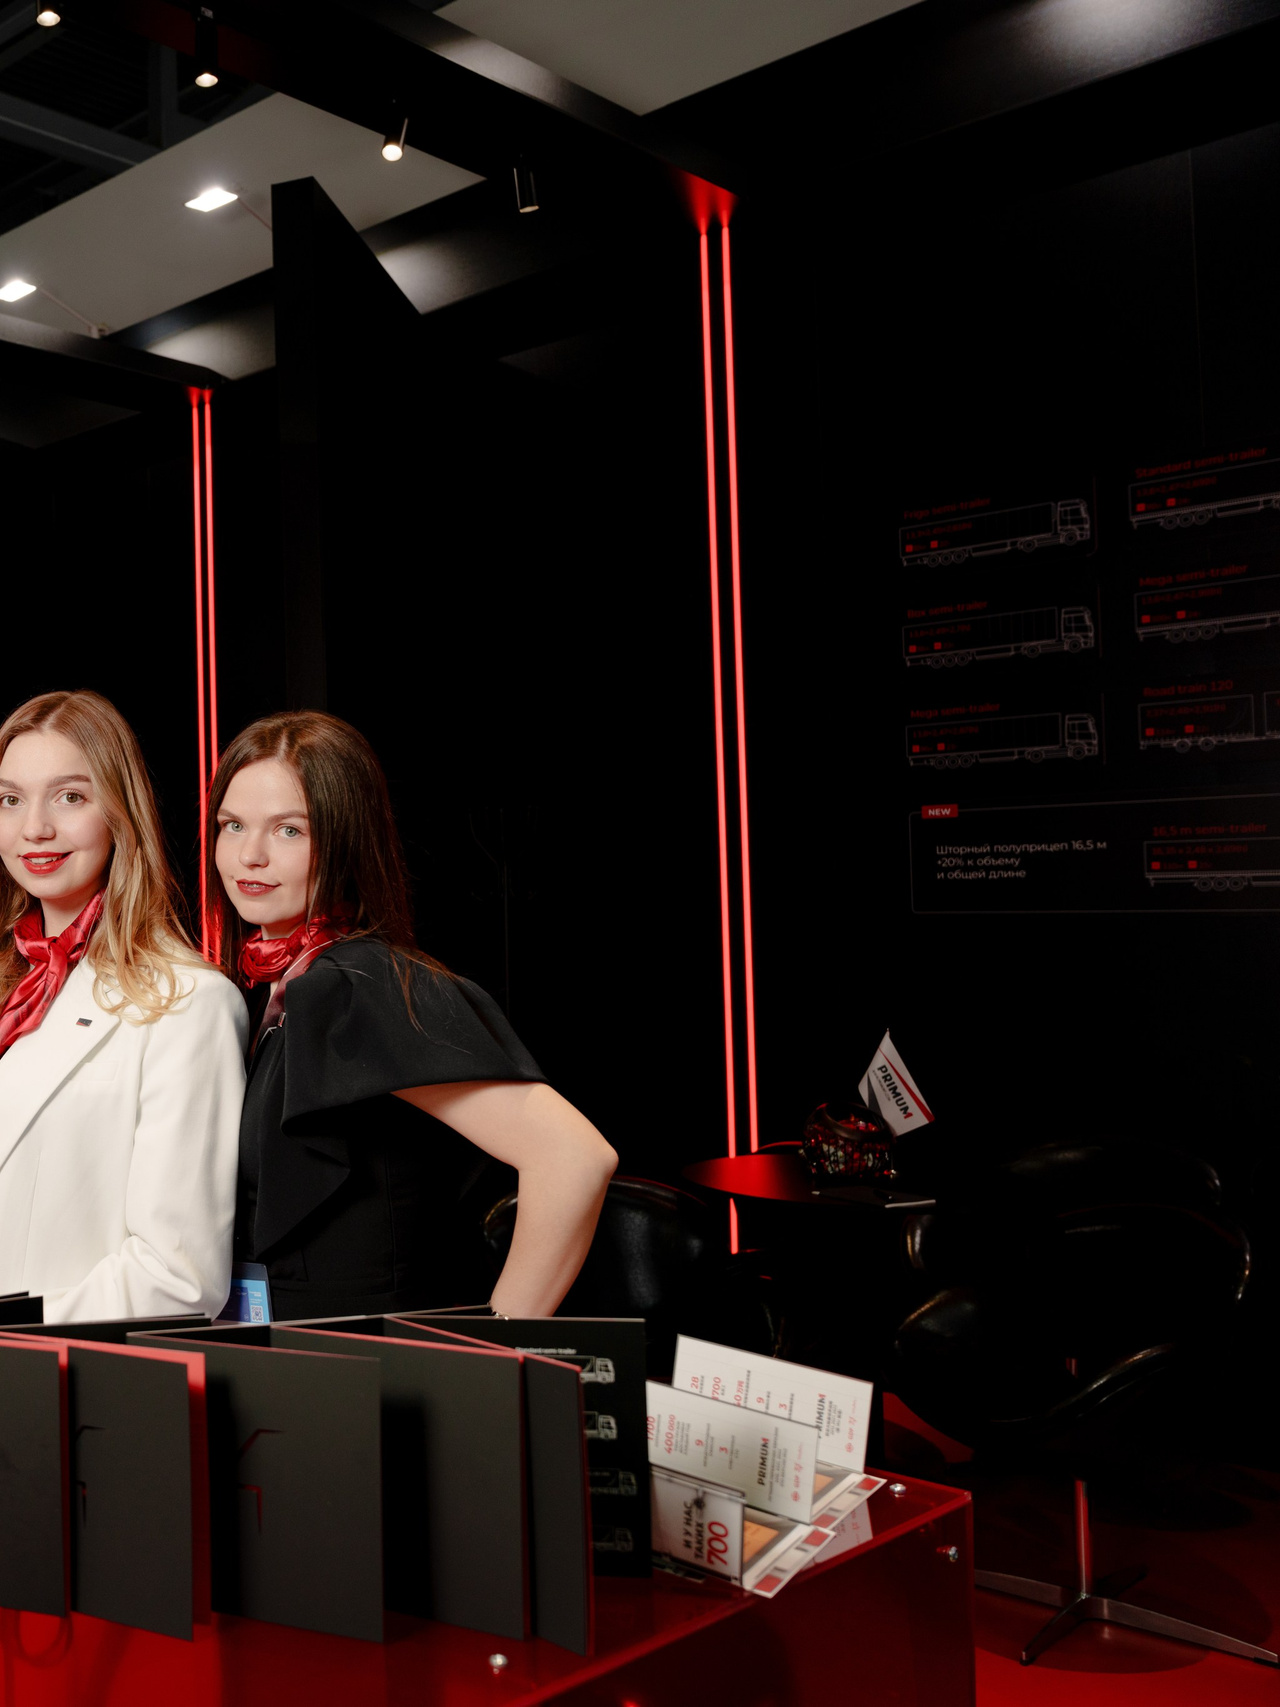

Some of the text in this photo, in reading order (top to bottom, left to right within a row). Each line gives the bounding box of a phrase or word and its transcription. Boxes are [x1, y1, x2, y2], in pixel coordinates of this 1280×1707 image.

[1209, 679, 1234, 692] 120
[909, 708, 939, 721] Mega
[927, 807, 952, 817] NEW
[935, 839, 1108, 856] Шторный полуприцеп 16,5 м
[936, 855, 1021, 868] +20% к объему
[936, 867, 1027, 882] и общей длине
[876, 1064, 914, 1120] PRIMUM
[756, 1436, 770, 1486] PRIMUM
[682, 1500, 695, 1550] И У НАС
[693, 1522, 705, 1560] ТАКИХ
[707, 1520, 729, 1567] 700
